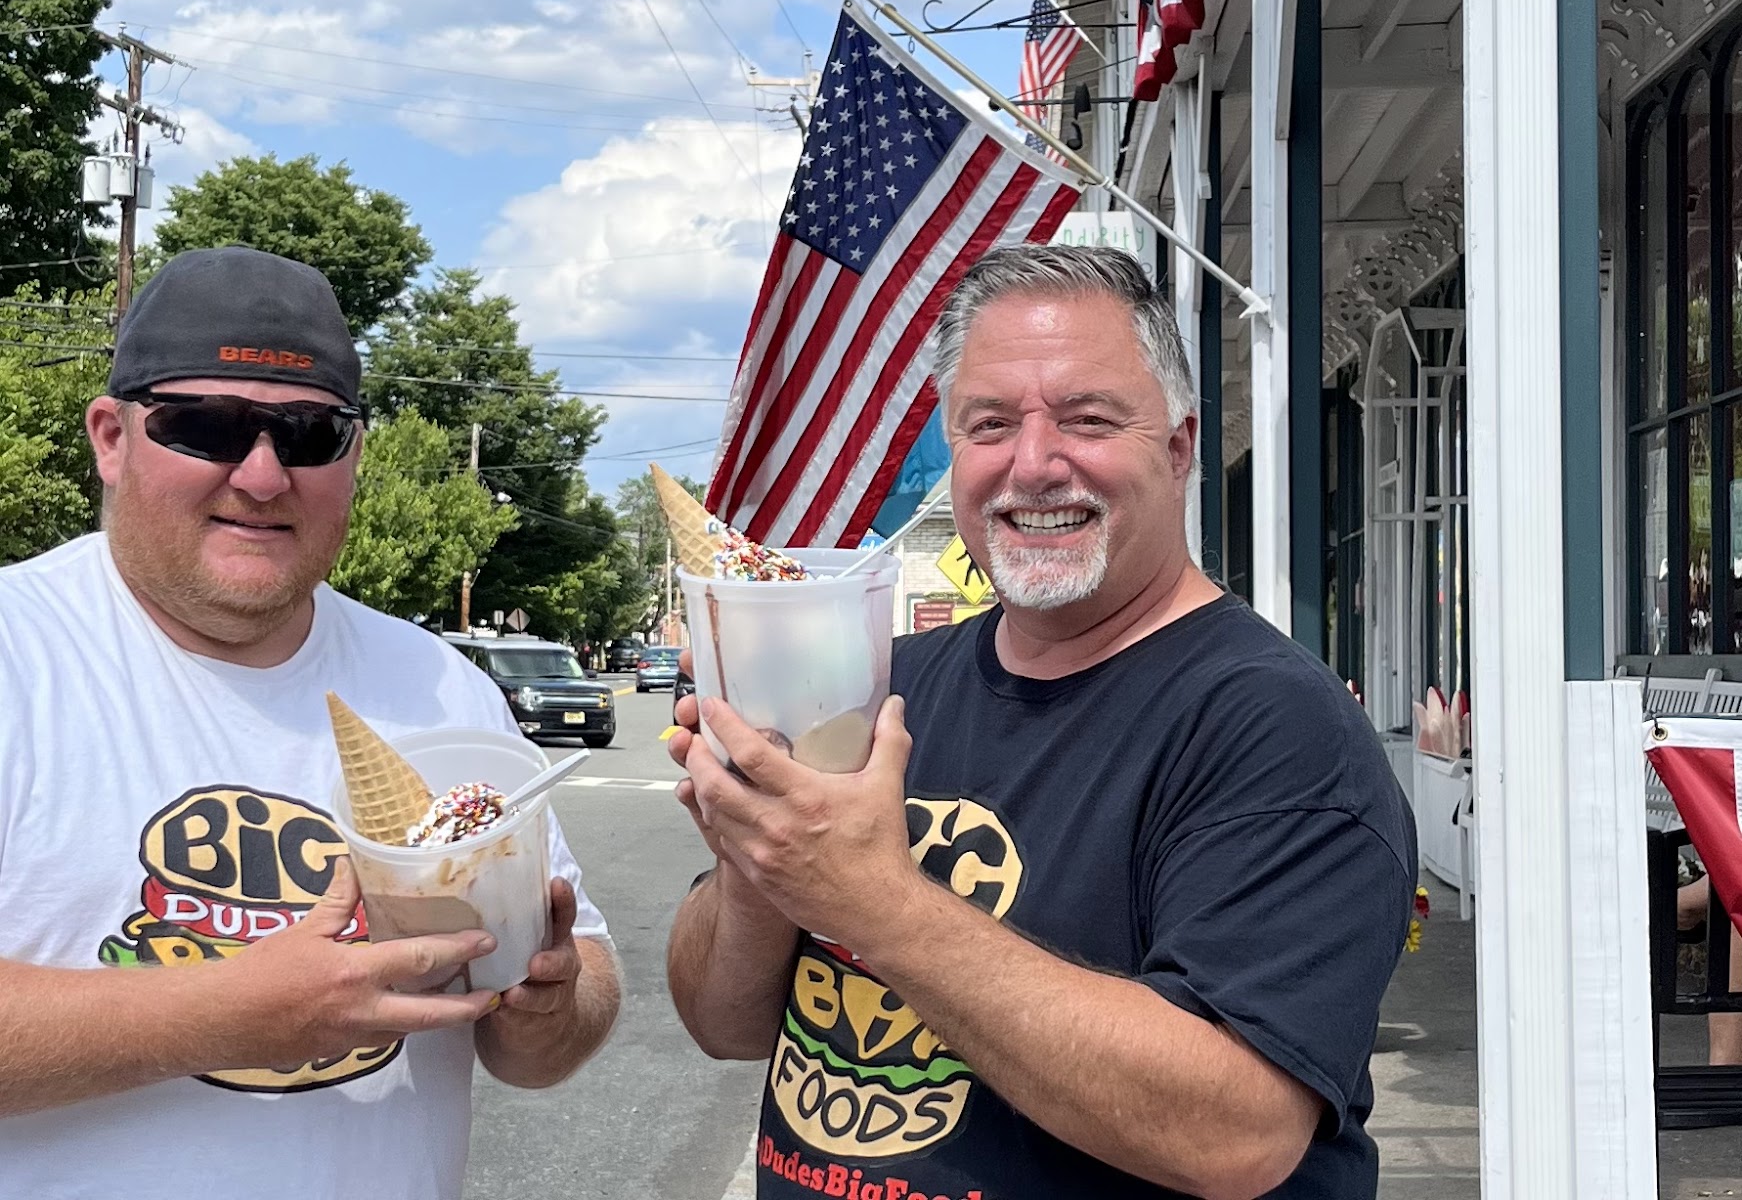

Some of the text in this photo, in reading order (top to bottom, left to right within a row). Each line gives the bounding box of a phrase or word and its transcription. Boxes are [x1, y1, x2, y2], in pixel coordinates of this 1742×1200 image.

[218, 346, 314, 369] BEARS
[162, 893, 359, 938] DUD
[776, 1046, 954, 1144] FOODS
